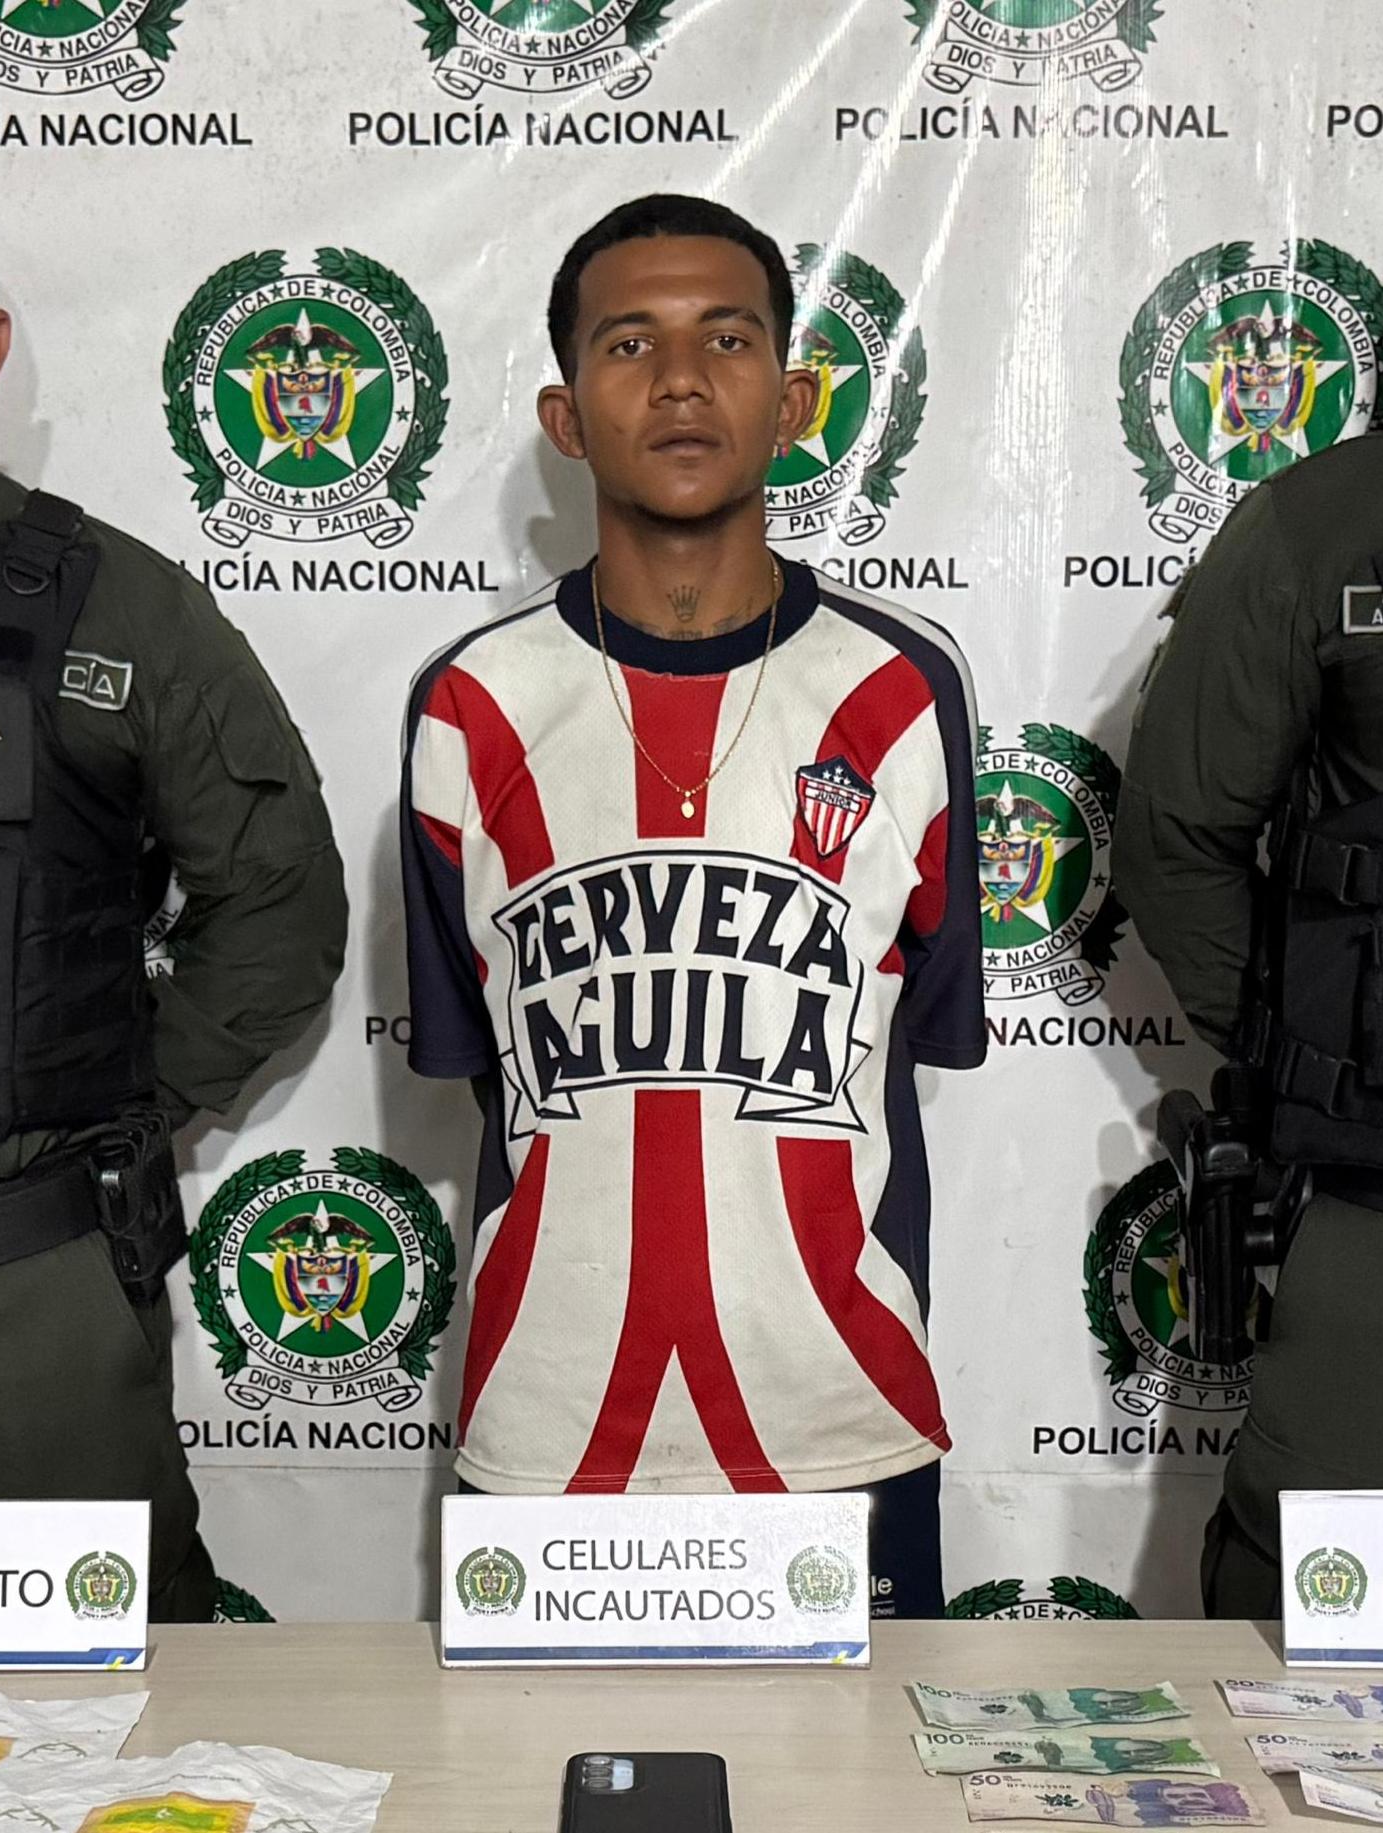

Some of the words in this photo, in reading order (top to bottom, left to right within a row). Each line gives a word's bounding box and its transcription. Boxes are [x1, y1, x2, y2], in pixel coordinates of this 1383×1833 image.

[41, 113, 252, 146] NACIONAL
[350, 104, 509, 146] POLICÍA
[526, 109, 734, 145] NACIONAL
[196, 288, 274, 387] REPUBLICA
[286, 279, 316, 296] DE
[335, 287, 412, 383] COLOMBIA
[215, 447, 286, 504] POLICIA
[311, 445, 400, 507] NACIONAL
[225, 501, 273, 531] DIOS
[288, 518, 302, 535] Y
[316, 502, 390, 534] PATRIA
[293, 561, 499, 592] NACIONAL
[508, 862, 853, 990] CERVEZA
[986, 1015, 1187, 1048] NACIONAL
[221, 1182, 294, 1268] REPUBLICA
[305, 1174, 334, 1189] DE
[352, 1181, 421, 1267] COLOMBIA
[238, 1321, 305, 1372] POLICIA
[327, 1321, 410, 1375] NACIONAL
[247, 1368, 293, 1395] DIOS
[306, 1383, 318, 1400] Y
[331, 1371, 400, 1399] PATRIA
[308, 1418, 459, 1452] NACION
[1033, 1418, 1185, 1456] POLICÍA
[541, 1538, 748, 1572] CELULARES
[534, 1589, 777, 1623] INCAUTADOS
[925, 1733, 965, 1746] 100
[1256, 1734, 1288, 1745] 50
[969, 1774, 1002, 1787] 50
